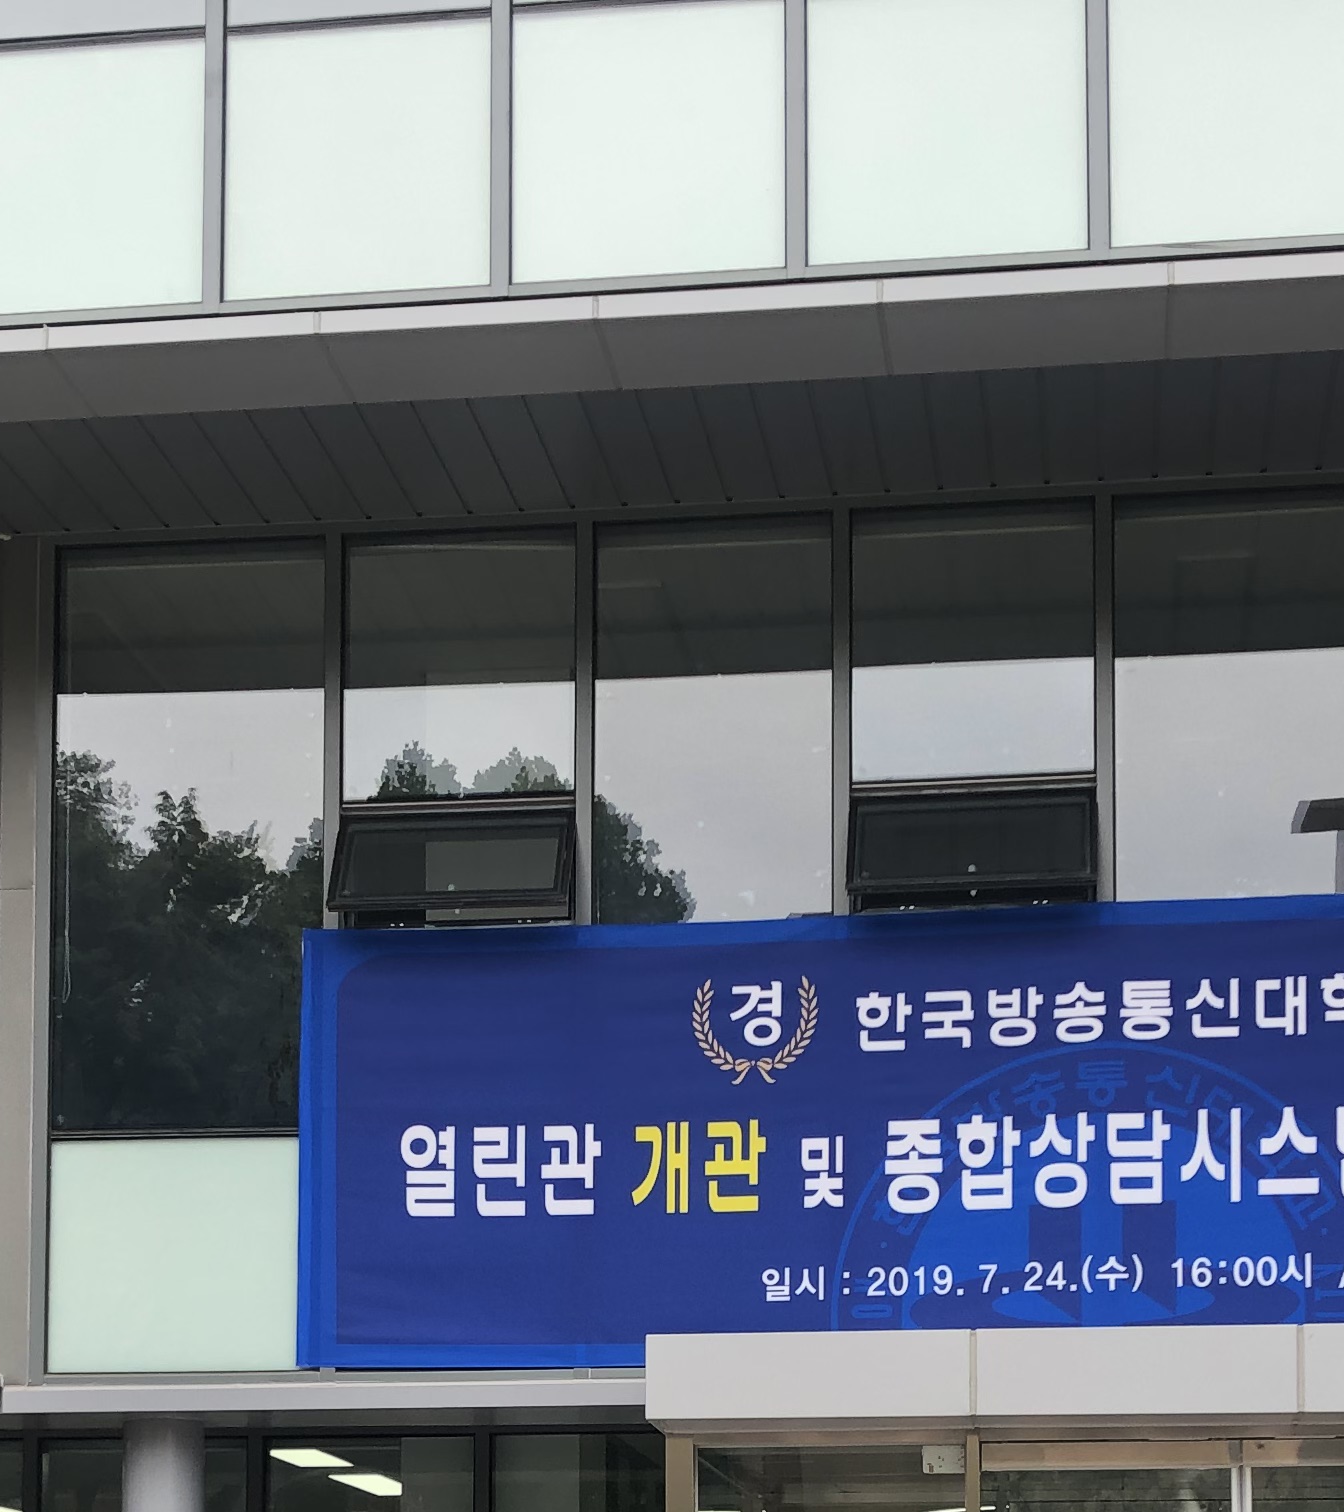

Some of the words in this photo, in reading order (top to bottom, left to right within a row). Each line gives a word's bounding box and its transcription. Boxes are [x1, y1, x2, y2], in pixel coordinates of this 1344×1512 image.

[729, 981, 782, 1046] 경
[400, 1123, 602, 1217] 열린관
[631, 1118, 767, 1214] 개관
[800, 1135, 845, 1209] 및
[761, 1265, 825, 1302] 일시
[866, 1264, 965, 1297] 2019.
[978, 1263, 1010, 1295] 7.
[1023, 1253, 1143, 1294] 24.(수)
[1171, 1252, 1312, 1289] 16:00시
